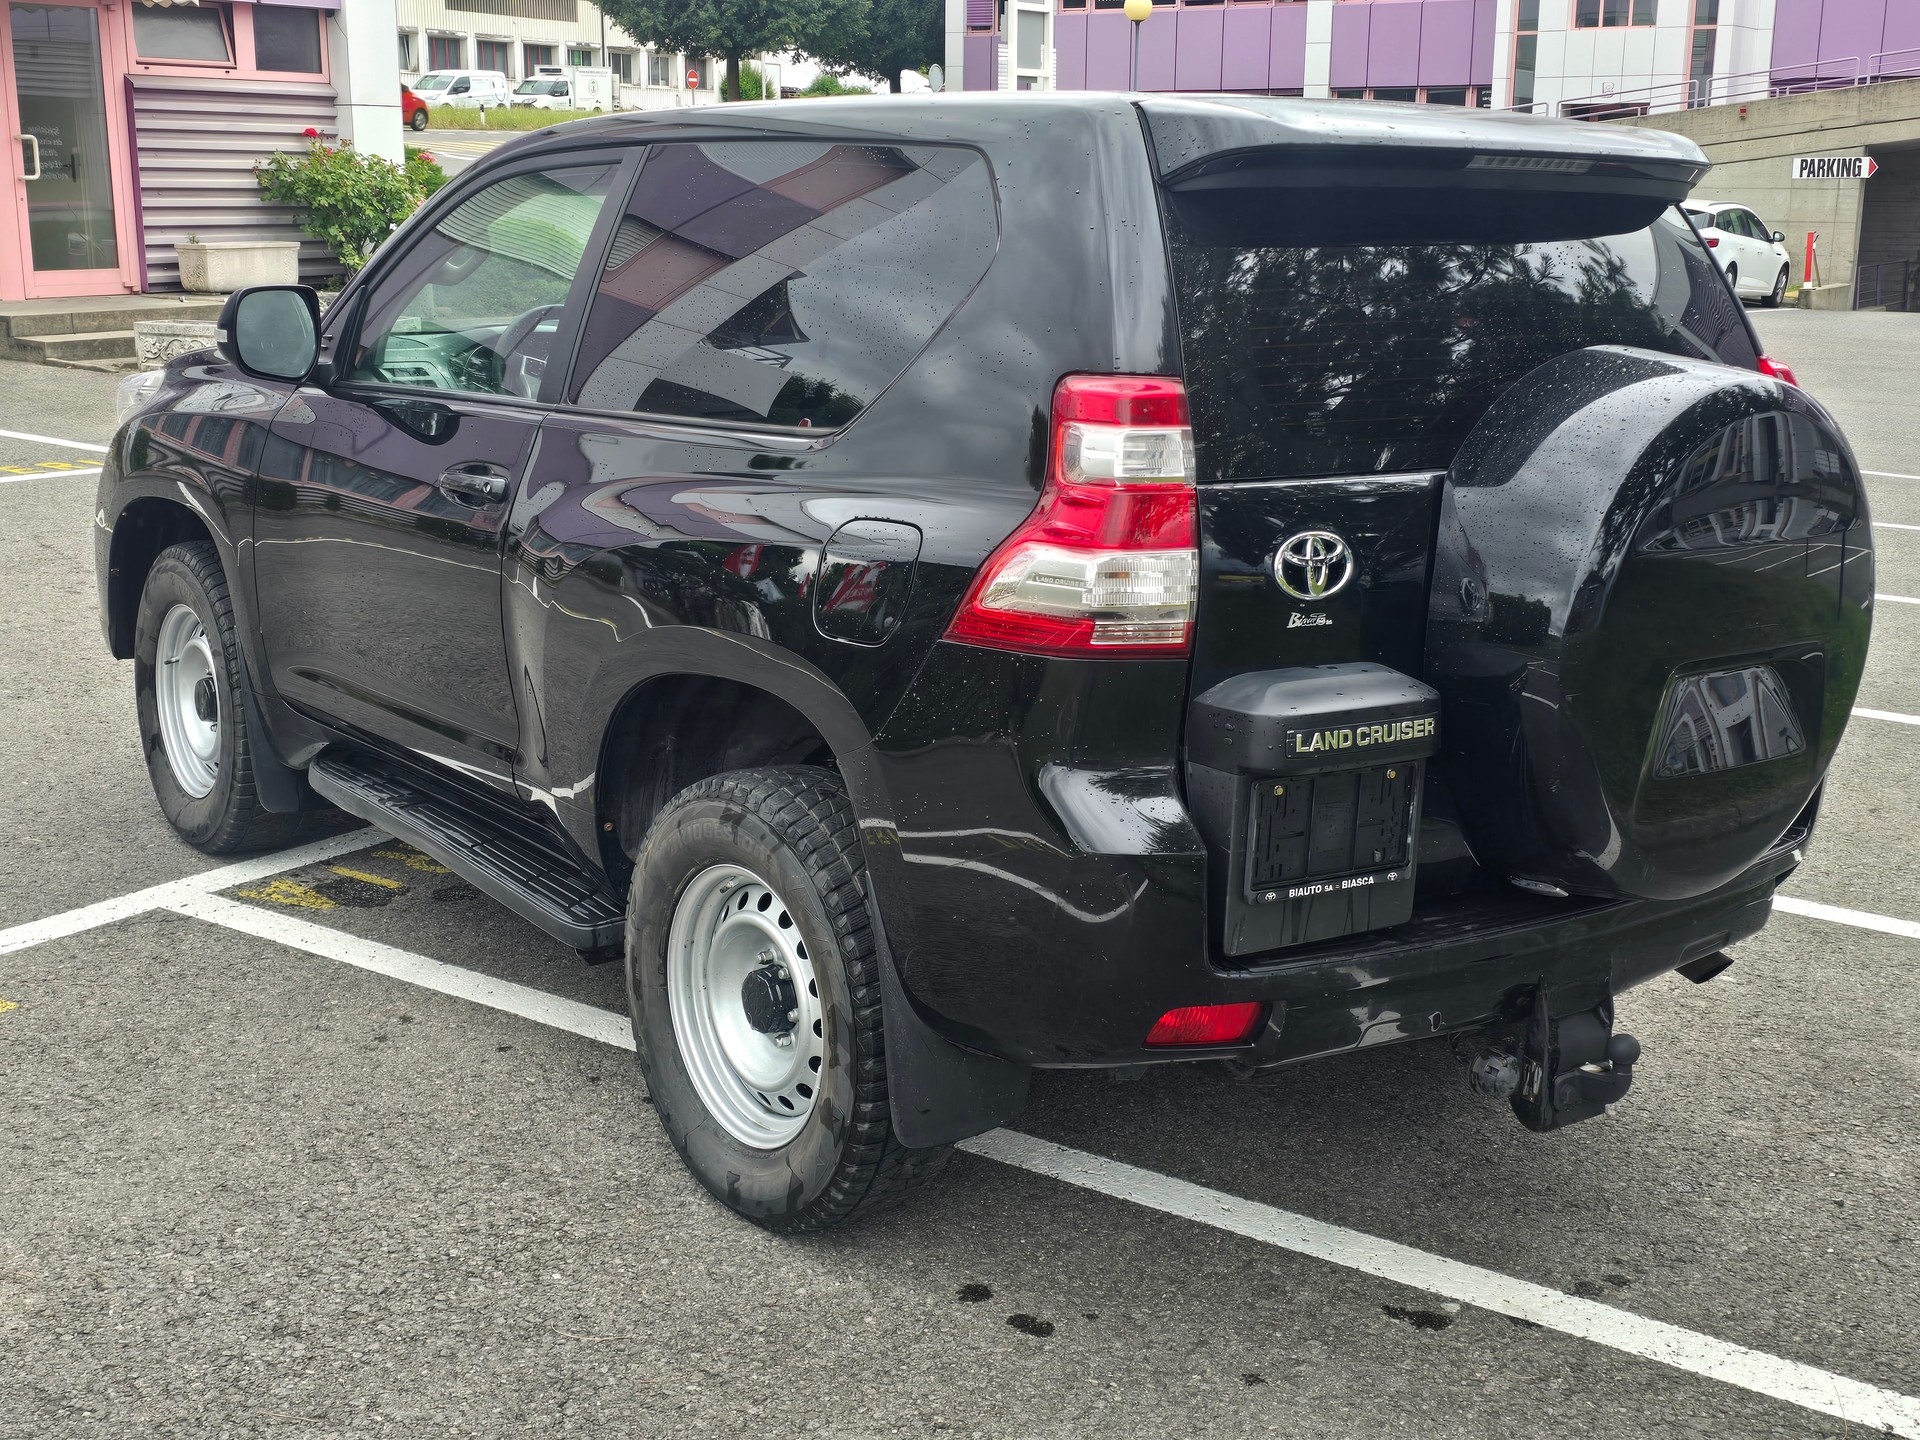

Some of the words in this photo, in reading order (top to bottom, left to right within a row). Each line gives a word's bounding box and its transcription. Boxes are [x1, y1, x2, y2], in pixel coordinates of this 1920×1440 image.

[1799, 158, 1863, 178] PARKING
[1296, 729, 1353, 753] LAND
[1356, 717, 1435, 747] CRUISER
[1288, 884, 1322, 898] BIAUTO
[1324, 884, 1333, 892] SA
[1341, 875, 1374, 889] BIASCA
